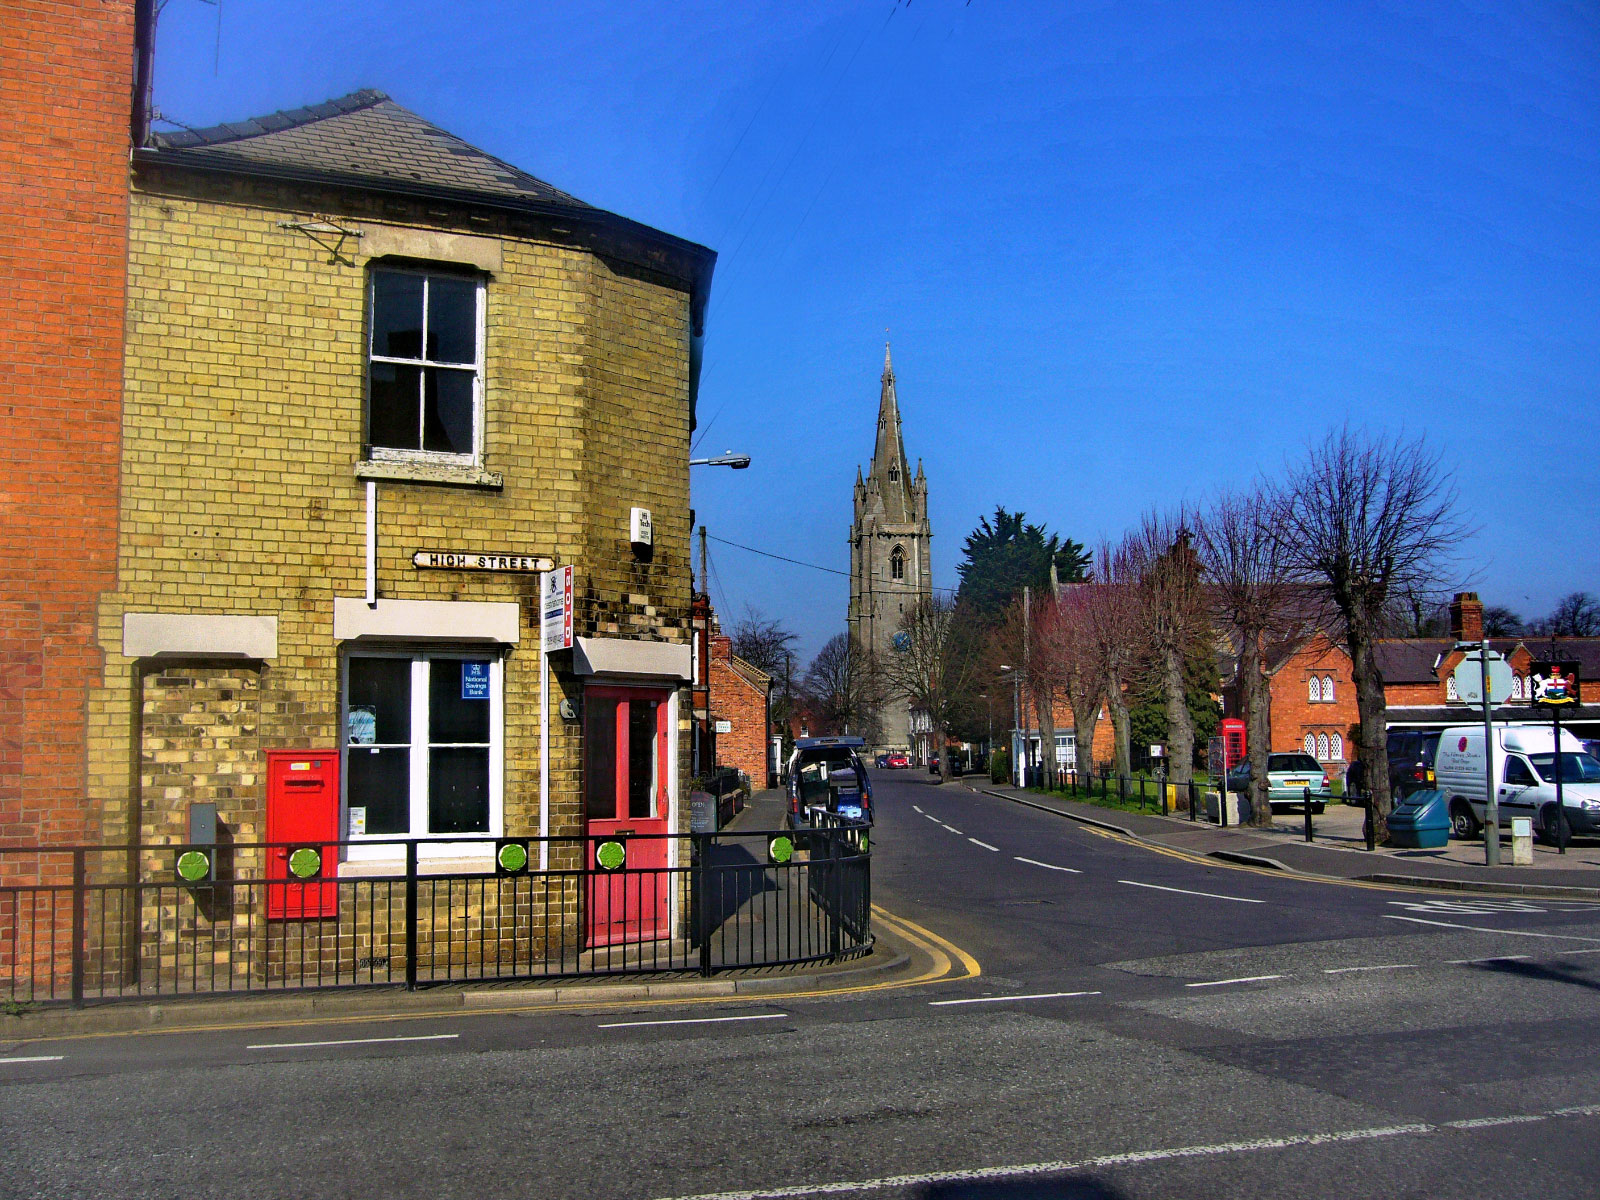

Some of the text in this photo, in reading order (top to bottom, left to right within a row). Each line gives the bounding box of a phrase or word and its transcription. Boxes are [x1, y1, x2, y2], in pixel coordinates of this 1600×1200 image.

[640, 518, 650, 527] Tech
[429, 554, 540, 569] HIGH STREET
